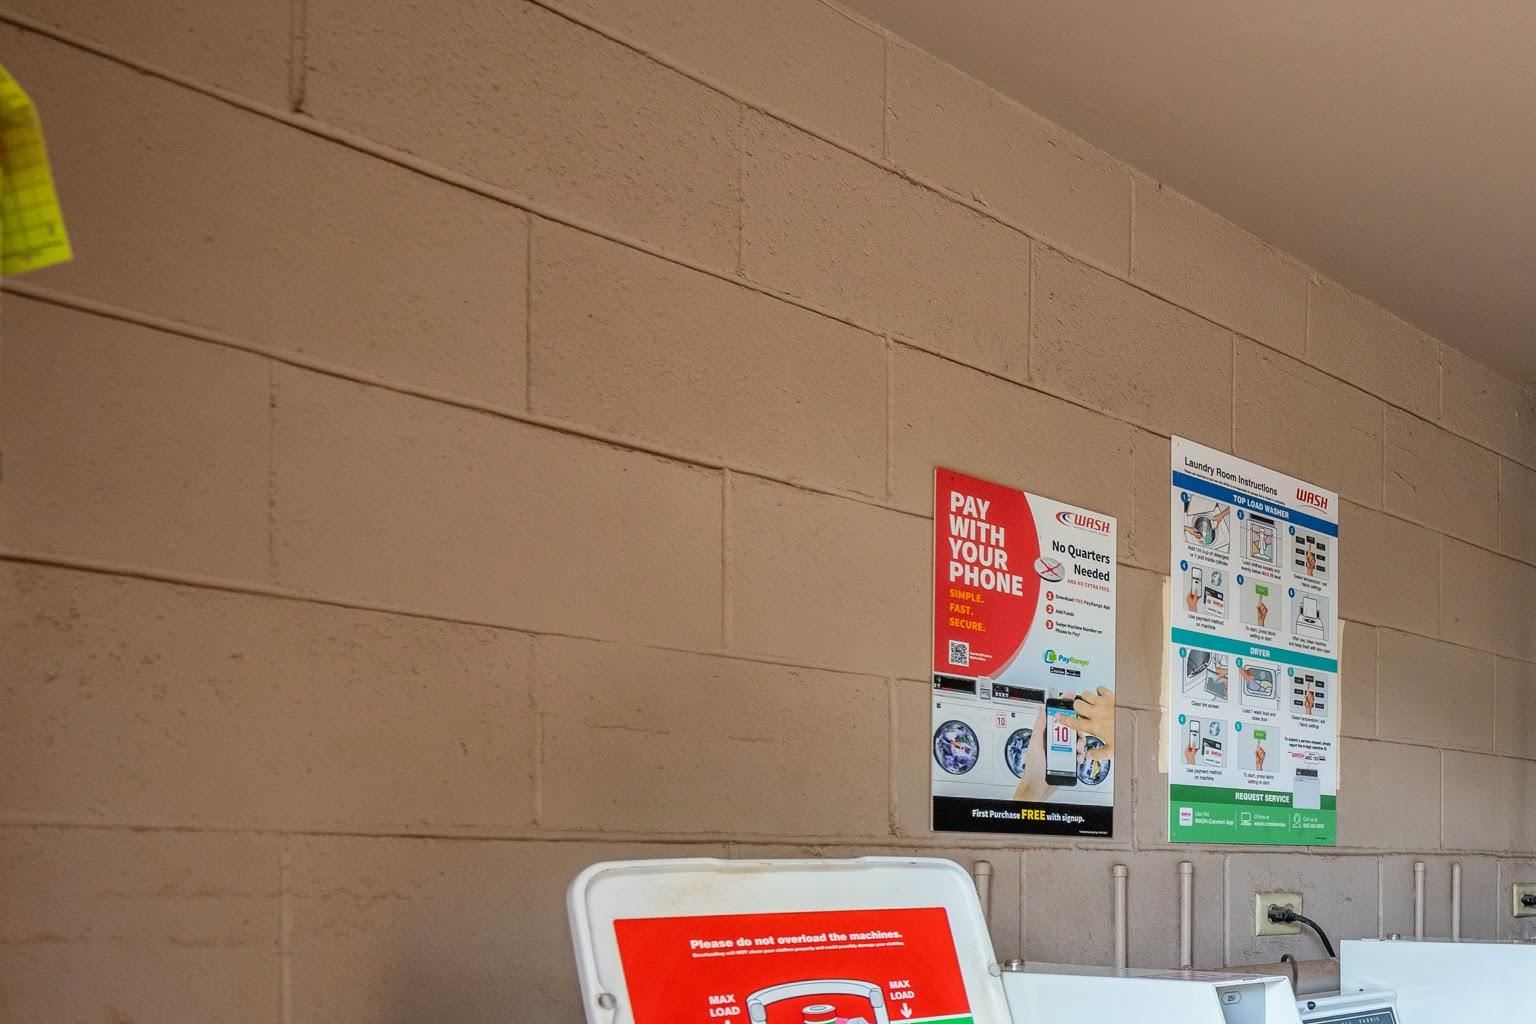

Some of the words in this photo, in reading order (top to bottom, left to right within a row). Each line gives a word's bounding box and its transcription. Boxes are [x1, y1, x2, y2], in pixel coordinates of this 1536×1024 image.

[1184, 456, 1213, 476] Laundry
[1216, 467, 1236, 482] Room
[1238, 474, 1277, 496] Instructions
[951, 491, 990, 520] PAY
[1296, 487, 1328, 510] WASH
[1232, 494, 1246, 505] TOP
[1247, 498, 1263, 511] LOAD
[1264, 504, 1289, 519] WASHER
[949, 514, 1005, 547] WITH
[1074, 514, 1110, 533] WASH
[949, 537, 1008, 571] YOUR
[1052, 540, 1066, 553] No
[1068, 544, 1110, 564] Quarters
[950, 561, 1023, 596] PHONE
[1074, 564, 1110, 581] Needed
[1085, 582, 1098, 590] EXTRA
[950, 589, 984, 603] SIMPLE.
[1056, 594, 1074, 602] Download
[1084, 600, 1102, 609] PayRange
[950, 603, 974, 616] FAST.
[949, 617, 986, 632] SECURE.
[1250, 647, 1270, 658] DRYER
[1058, 655, 1089, 666] PayRange
[997, 717, 1005, 726] 10
[1054, 726, 1069, 742] 10
[1235, 792, 1263, 801] REQUEST
[1264, 794, 1289, 803] SERVICE
[972, 809, 988, 818] First
[989, 810, 1020, 820] Purchase
[1021, 809, 1046, 820] FREE
[1047, 813, 1061, 822] with
[1062, 814, 1085, 823] signup.
[690, 939, 733, 949] Please
[736, 937, 752, 947] do
[755, 936, 775, 946] not
[777, 933, 826, 945] overload
[828, 932, 847, 942] the
[849, 930, 903, 941] machines.
[889, 980, 911, 989] MAX
[708, 993, 736, 1005] MAX
[890, 991, 915, 1000] LOAD
[709, 1006, 740, 1018] LOAD
[1359, 1016, 1380, 1024] FABRIC
